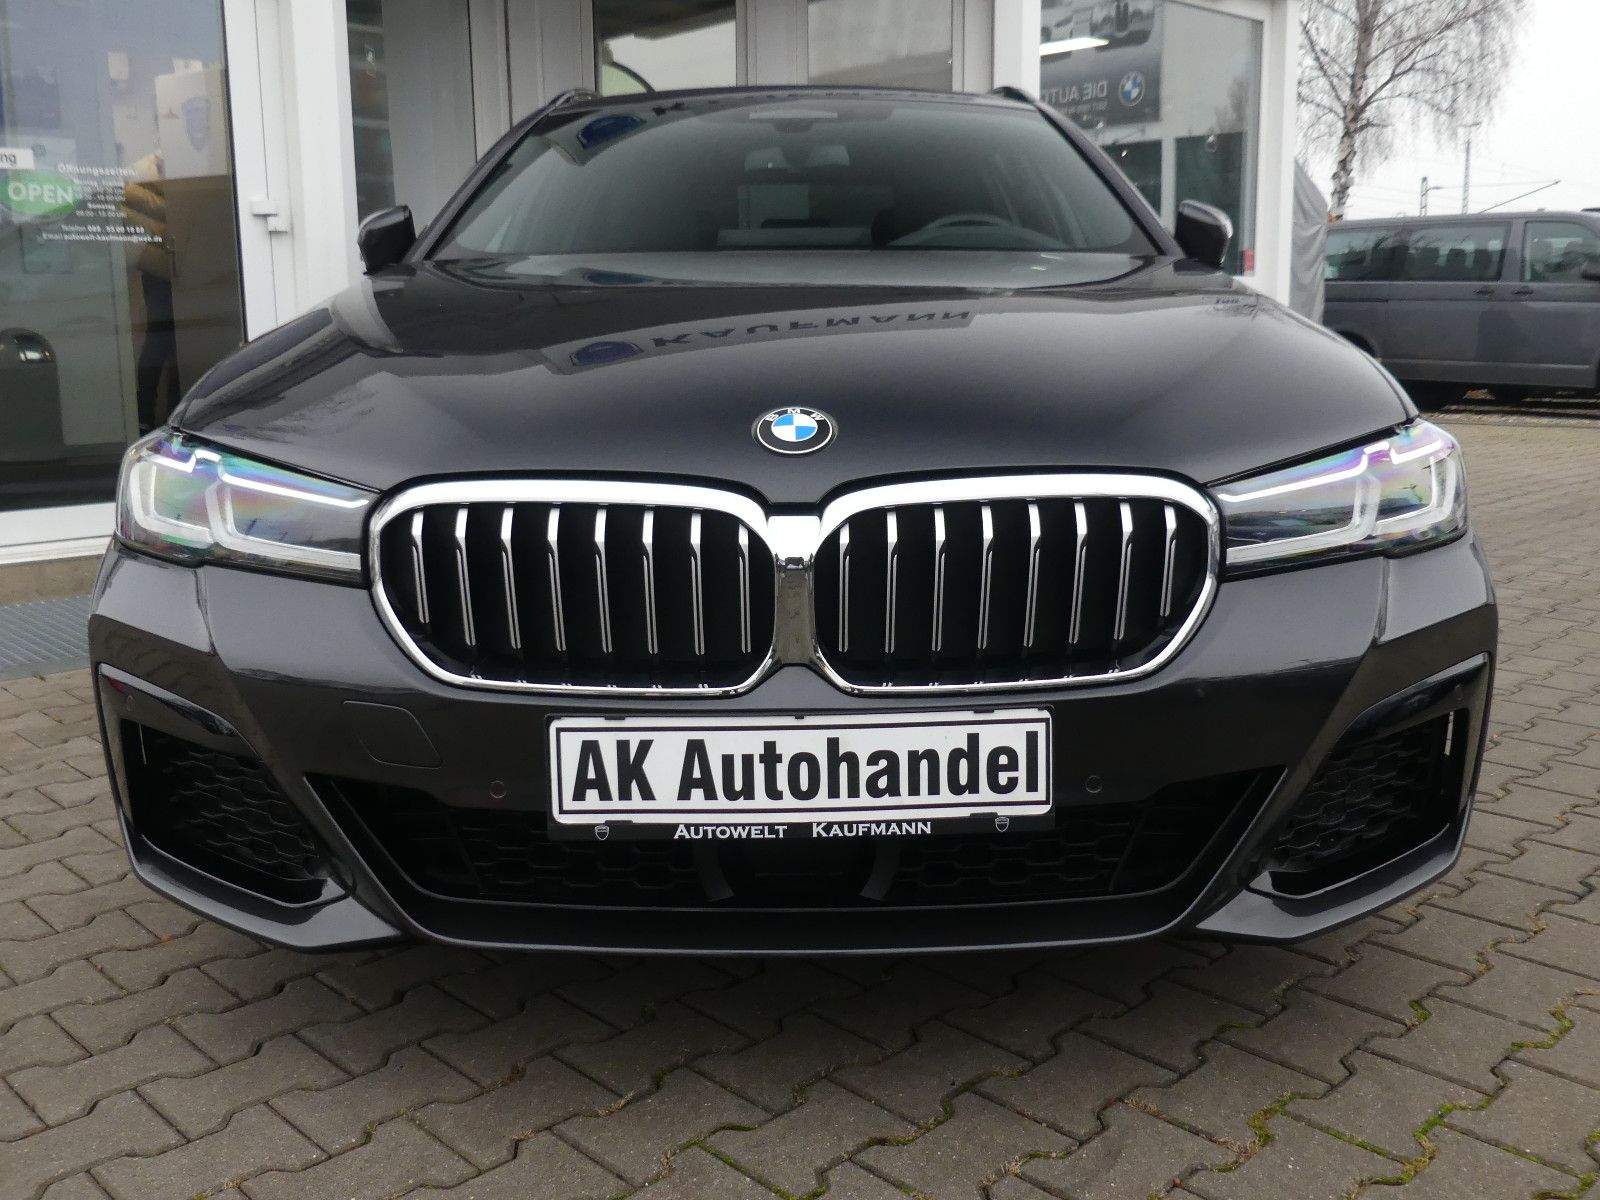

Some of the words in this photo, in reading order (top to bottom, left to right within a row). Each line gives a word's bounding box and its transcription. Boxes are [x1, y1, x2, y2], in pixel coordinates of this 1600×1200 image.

[8, 182, 73, 204] OPEN
[572, 739, 656, 801] AK
[677, 731, 1039, 801] Autohandel
[673, 823, 788, 840] AUTOWELT
[811, 820, 932, 839] KAUFMANN
